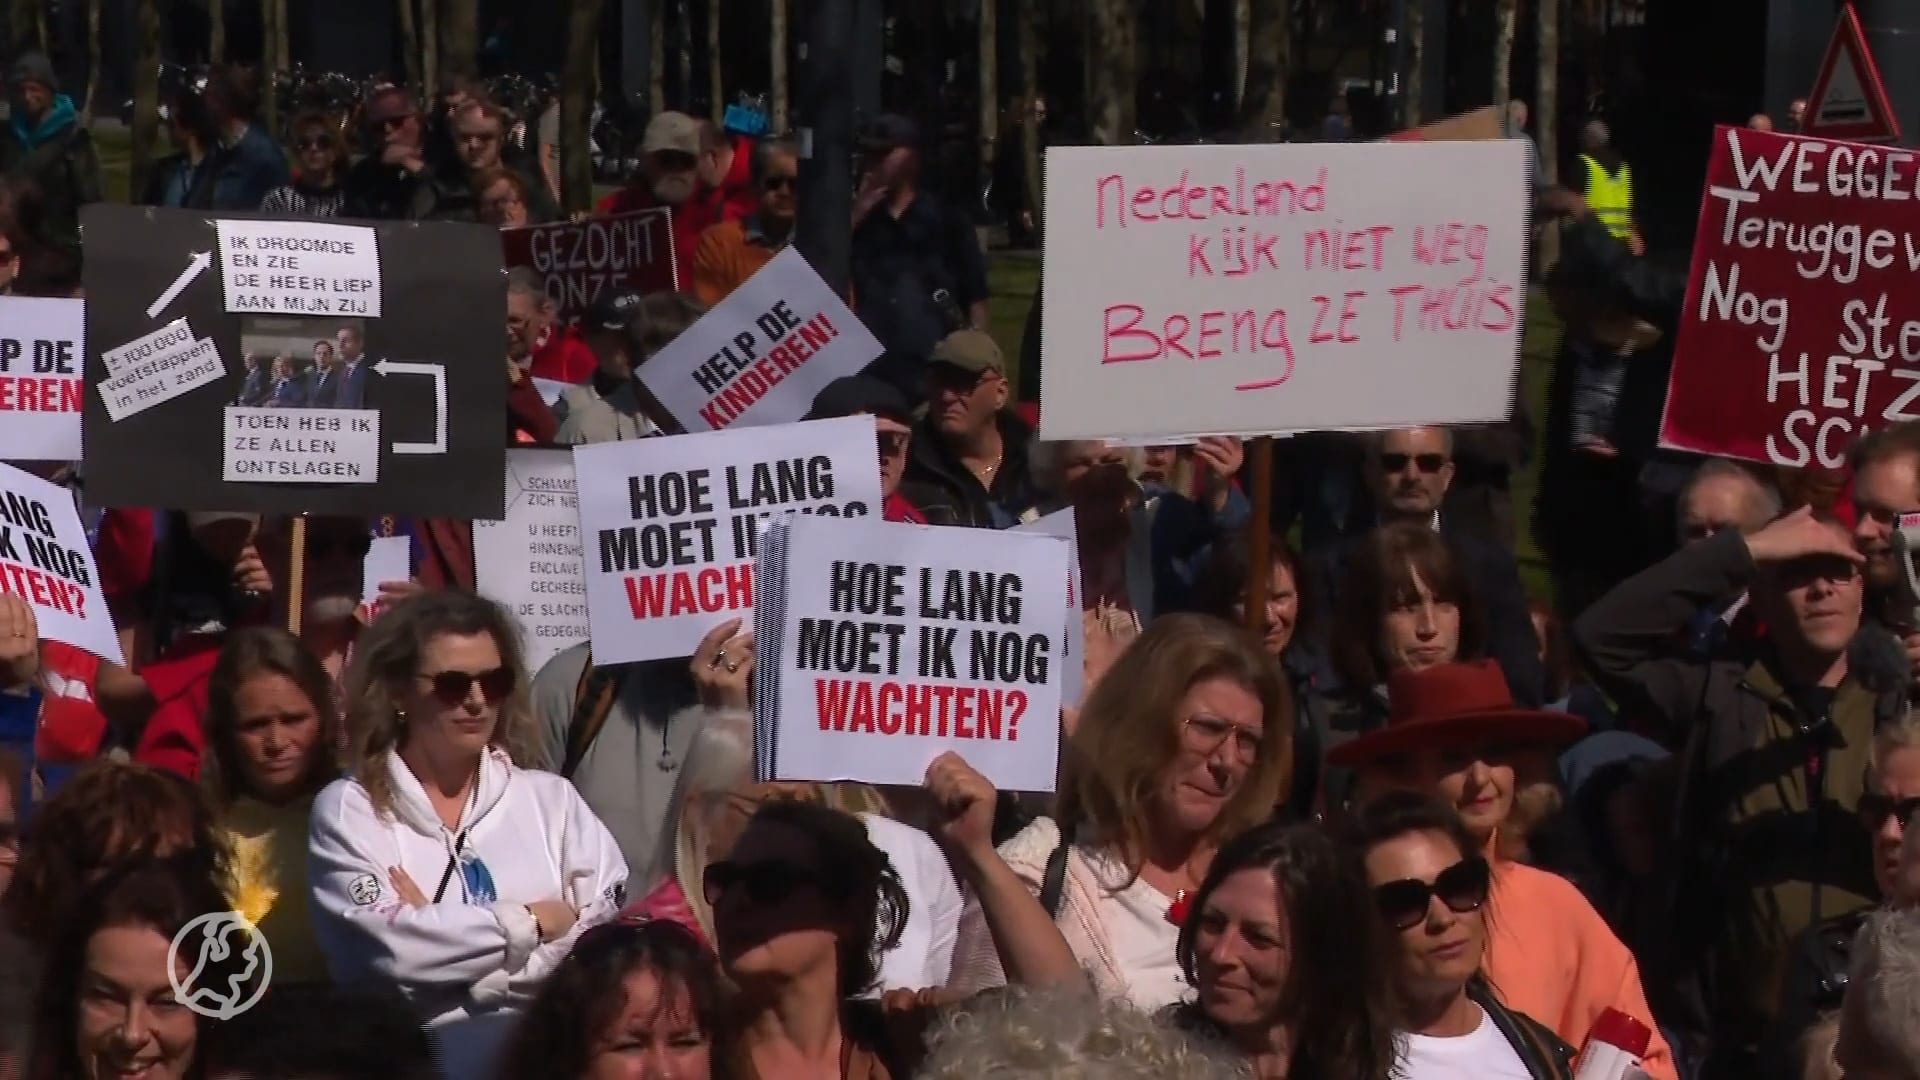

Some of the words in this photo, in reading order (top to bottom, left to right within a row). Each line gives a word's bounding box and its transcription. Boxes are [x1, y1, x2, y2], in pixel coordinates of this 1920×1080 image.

[1727, 128, 1920, 201] WEGGE
[230, 236, 249, 249] IK
[256, 237, 355, 255] DROOMDE
[232, 254, 258, 267] EN
[267, 255, 299, 270] ZIE
[531, 216, 656, 273] GEZOCHT
[234, 274, 260, 288] DE
[269, 275, 326, 292] HEER
[333, 279, 373, 292] LIEP
[235, 295, 275, 310] AAN
[283, 296, 330, 312] MIJN
[338, 299, 368, 313] ZIJ
[545, 272, 628, 313] ONZ
[1699, 260, 1788, 351] Nog
[1309, 290, 1367, 344] ZE
[33, 339, 74, 374] DE
[106, 342, 212, 392] voetstappen
[692, 331, 756, 394] HELP
[756, 299, 802, 343] DE
[699, 312, 840, 430] KINDEREN!
[115, 395, 133, 408] in
[135, 380, 167, 400] het
[175, 358, 216, 385] zand
[234, 414, 289, 430] TOEN
[299, 416, 341, 431] HEB
[351, 418, 372, 433] IK
[234, 437, 260, 451] ZE
[269, 438, 336, 453] ALLEN
[1765, 409, 1872, 469] SC
[234, 459, 361, 477] ONTSLAGEN
[628, 469, 713, 519] HOE
[725, 455, 834, 509] LANG
[527, 493, 555, 507] ZICH
[528, 524, 538, 536] U
[598, 517, 717, 573] MOET
[23, 531, 91, 588] NOG
[530, 561, 579, 575] ENCLAVE
[519, 604, 534, 616] DE
[624, 563, 757, 620] WACH
[830, 560, 906, 616] HOE
[919, 567, 1023, 625] LANG
[796, 617, 906, 675] MOET
[918, 625, 958, 679] IK
[969, 629, 1050, 685] NOG
[814, 678, 1029, 742] WACHTEN?
